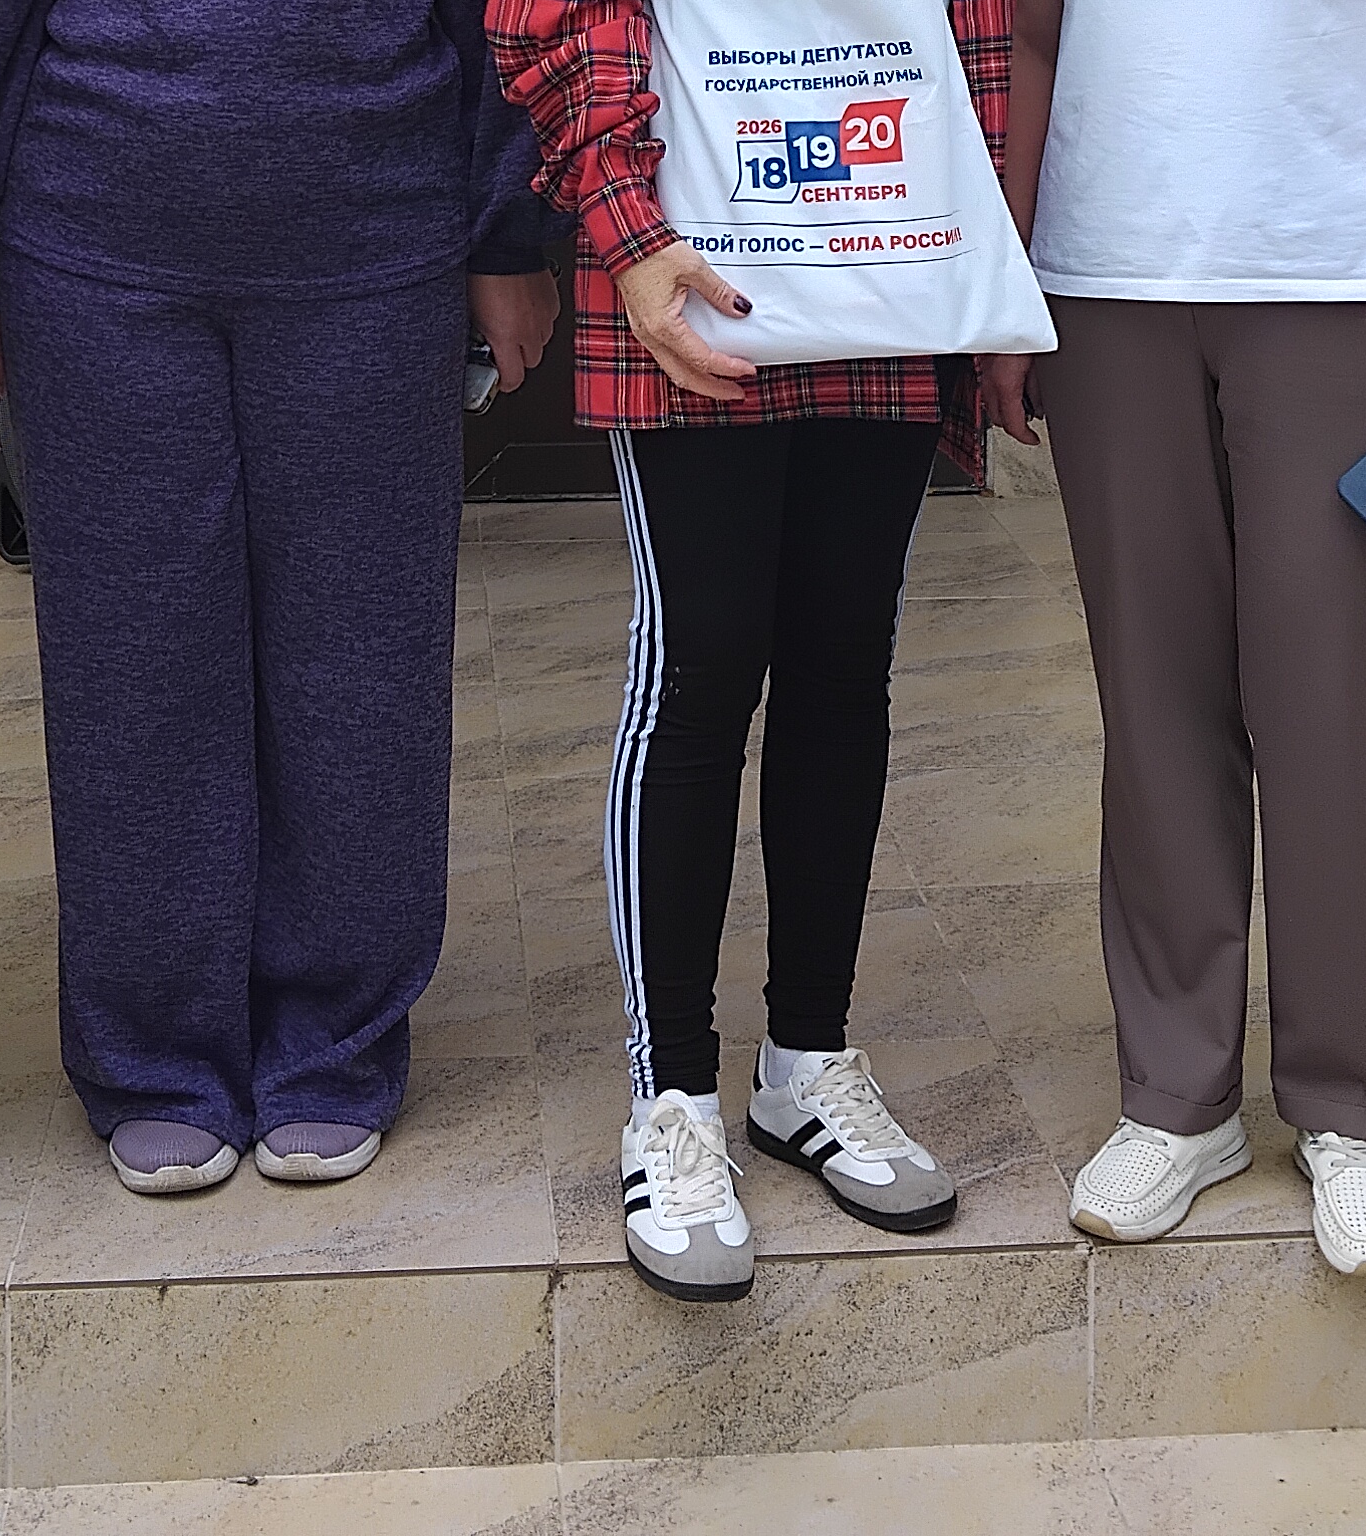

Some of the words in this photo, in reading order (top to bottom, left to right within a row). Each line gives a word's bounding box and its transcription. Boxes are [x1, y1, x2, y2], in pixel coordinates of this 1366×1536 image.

[708, 49, 796, 66] ВЫБОРЫ
[801, 41, 913, 66] ДЕПУТАТОВ
[705, 69, 869, 92] ГОСУДАРСТВЕННОЙ
[873, 68, 923, 87] ДУМЫ
[736, 119, 782, 135] 2026
[745, 157, 788, 189] 18
[792, 135, 836, 170] 19
[844, 114, 896, 151] 20
[801, 183, 907, 204] СЕНТЯБРЯ
[739, 237, 805, 253] ГОЛОС
[828, 236, 885, 253] СИЛА
